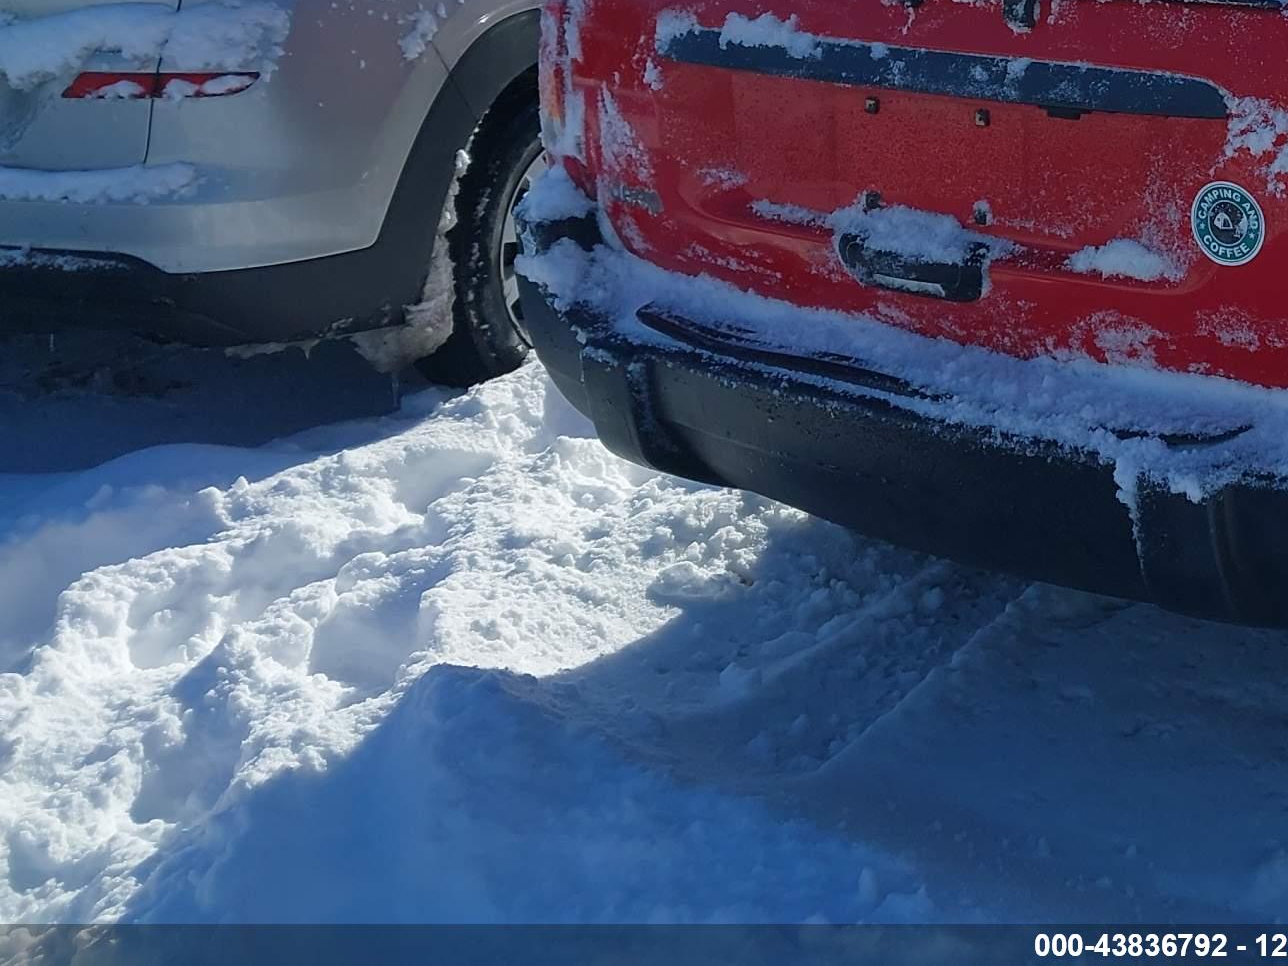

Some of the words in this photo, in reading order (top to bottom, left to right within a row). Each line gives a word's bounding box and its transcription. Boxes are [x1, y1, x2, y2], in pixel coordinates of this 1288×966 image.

[1198, 188, 1241, 219] CAMPING
[1242, 202, 1259, 230] AND
[1203, 234, 1250, 258] COFFEE
